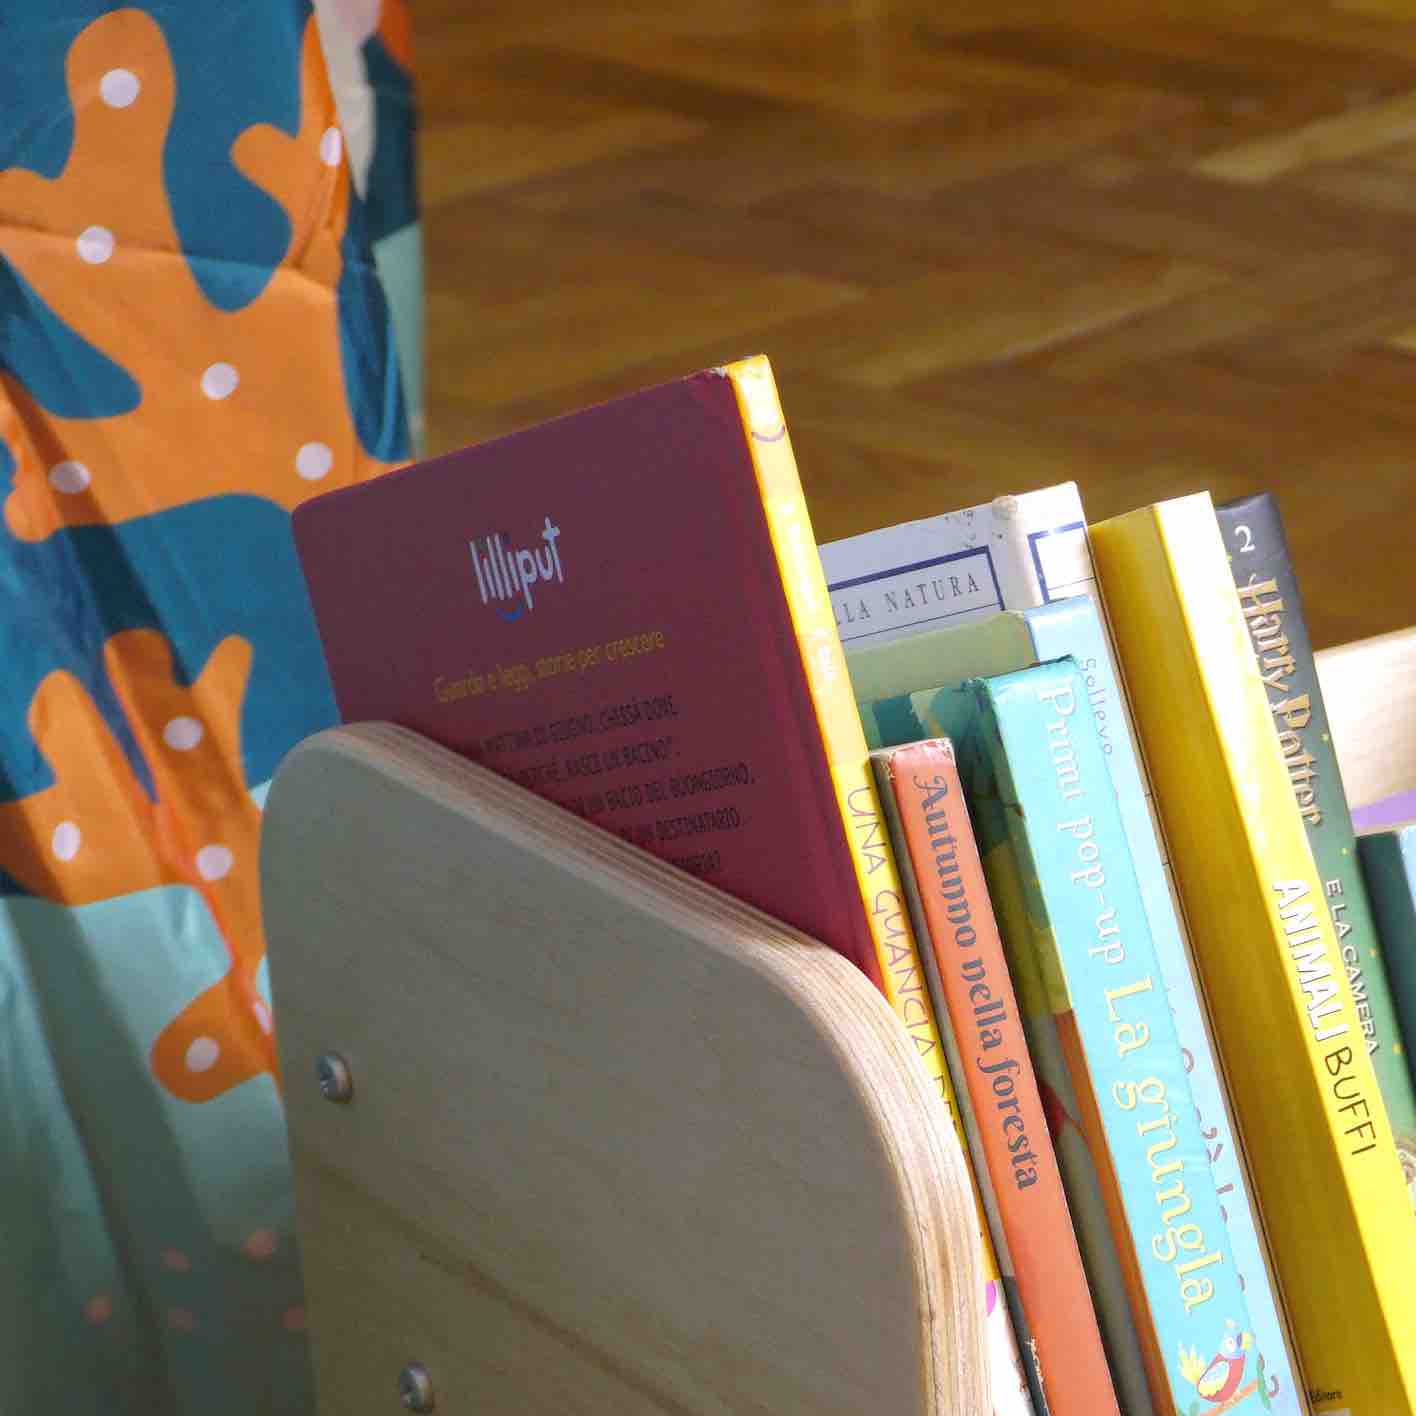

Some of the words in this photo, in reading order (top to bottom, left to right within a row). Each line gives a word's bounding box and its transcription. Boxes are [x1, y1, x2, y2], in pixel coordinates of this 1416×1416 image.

[469, 516, 563, 611] lilliput
[1234, 525, 1255, 552] 2
[837, 599, 871, 625] LA
[884, 572, 981, 613] NATURA
[1039, 675, 1087, 801] Primi
[1236, 573, 1297, 693] Harry
[1272, 693, 1321, 826] Potter
[847, 783, 887, 875] UNA
[872, 889, 937, 1058] GUANCIA
[914, 775, 979, 948] Autunno
[1056, 816, 1126, 965] pop-up
[1325, 878, 1344, 897] E
[1331, 902, 1353, 938] LA
[961, 958, 1008, 1051] nella
[1104, 976, 1153, 1057] La
[1272, 879, 1349, 1041] ANIMALI
[1324, 1045, 1378, 1156] BUFFI
[1343, 945, 1381, 1057] CAMERA
[977, 1056, 1039, 1190] foresta
[1112, 1076, 1223, 1312] giungla
